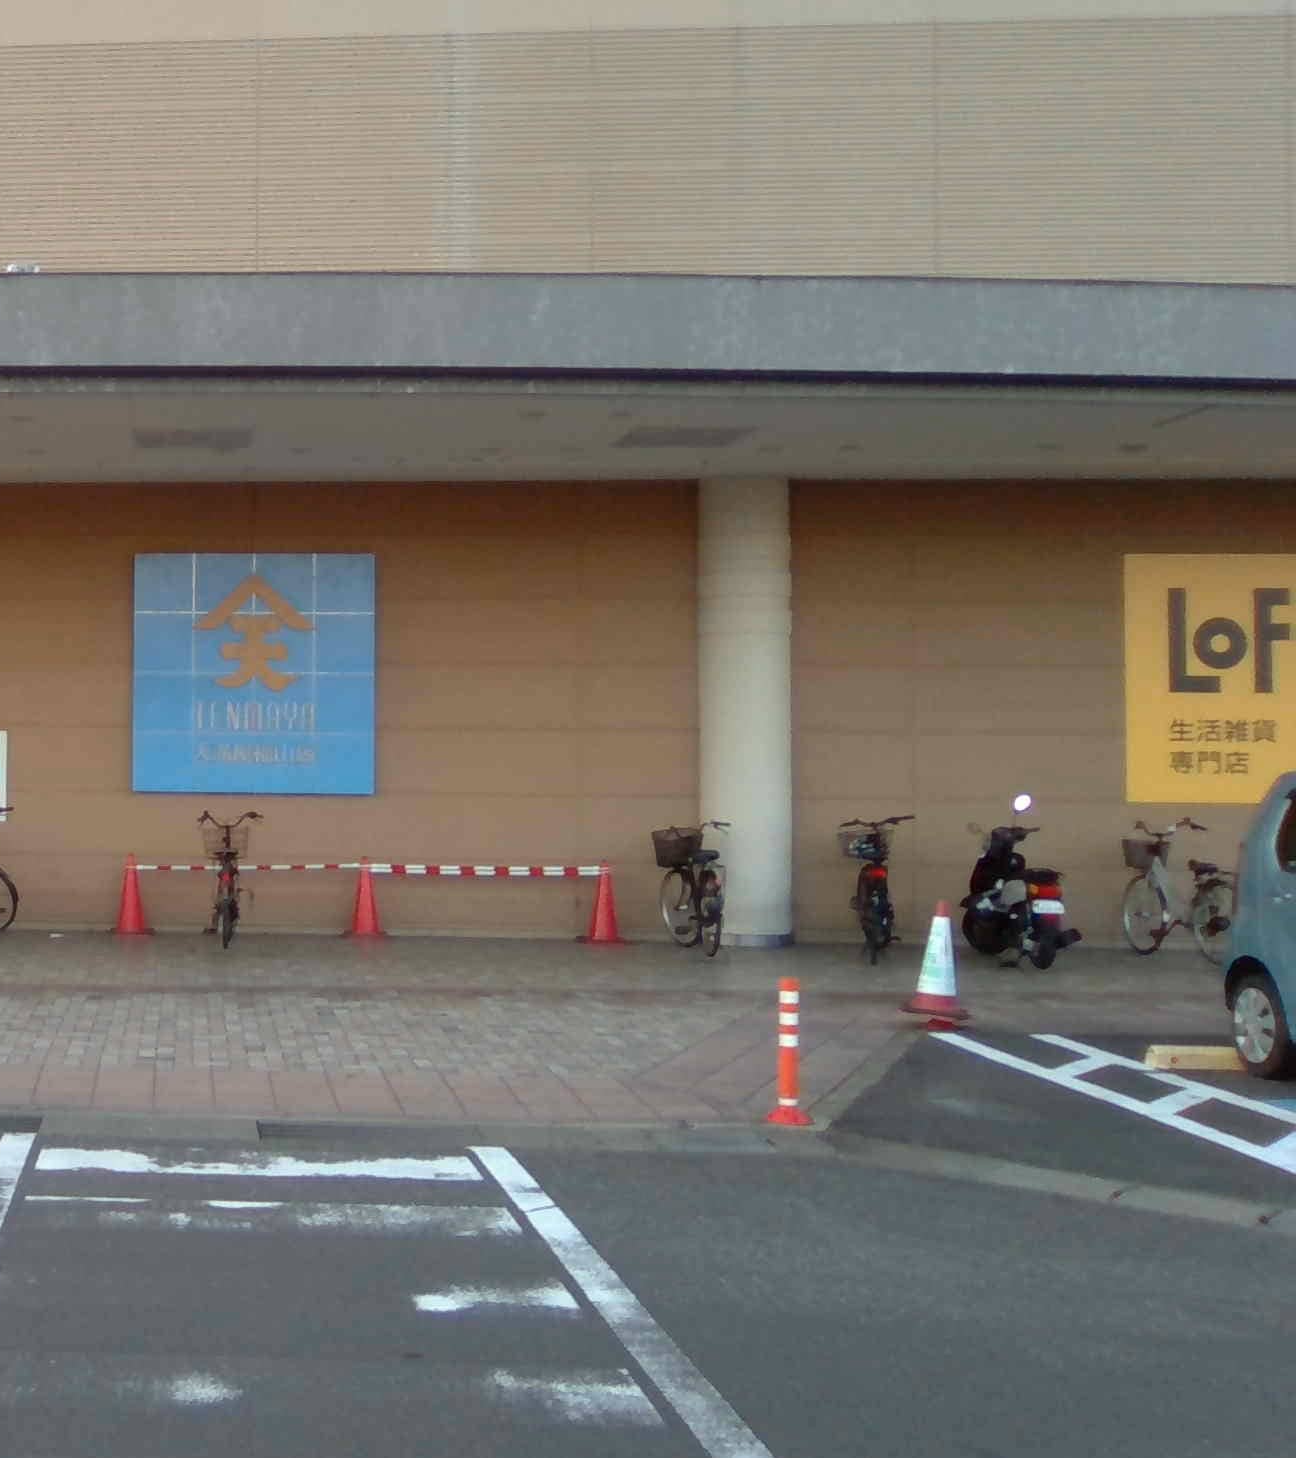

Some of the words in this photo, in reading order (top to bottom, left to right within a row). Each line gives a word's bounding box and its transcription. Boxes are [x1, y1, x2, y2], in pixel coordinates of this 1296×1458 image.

[1169, 719, 1277, 743] 生活雑貨
[1169, 751, 1249, 774] 専門店
